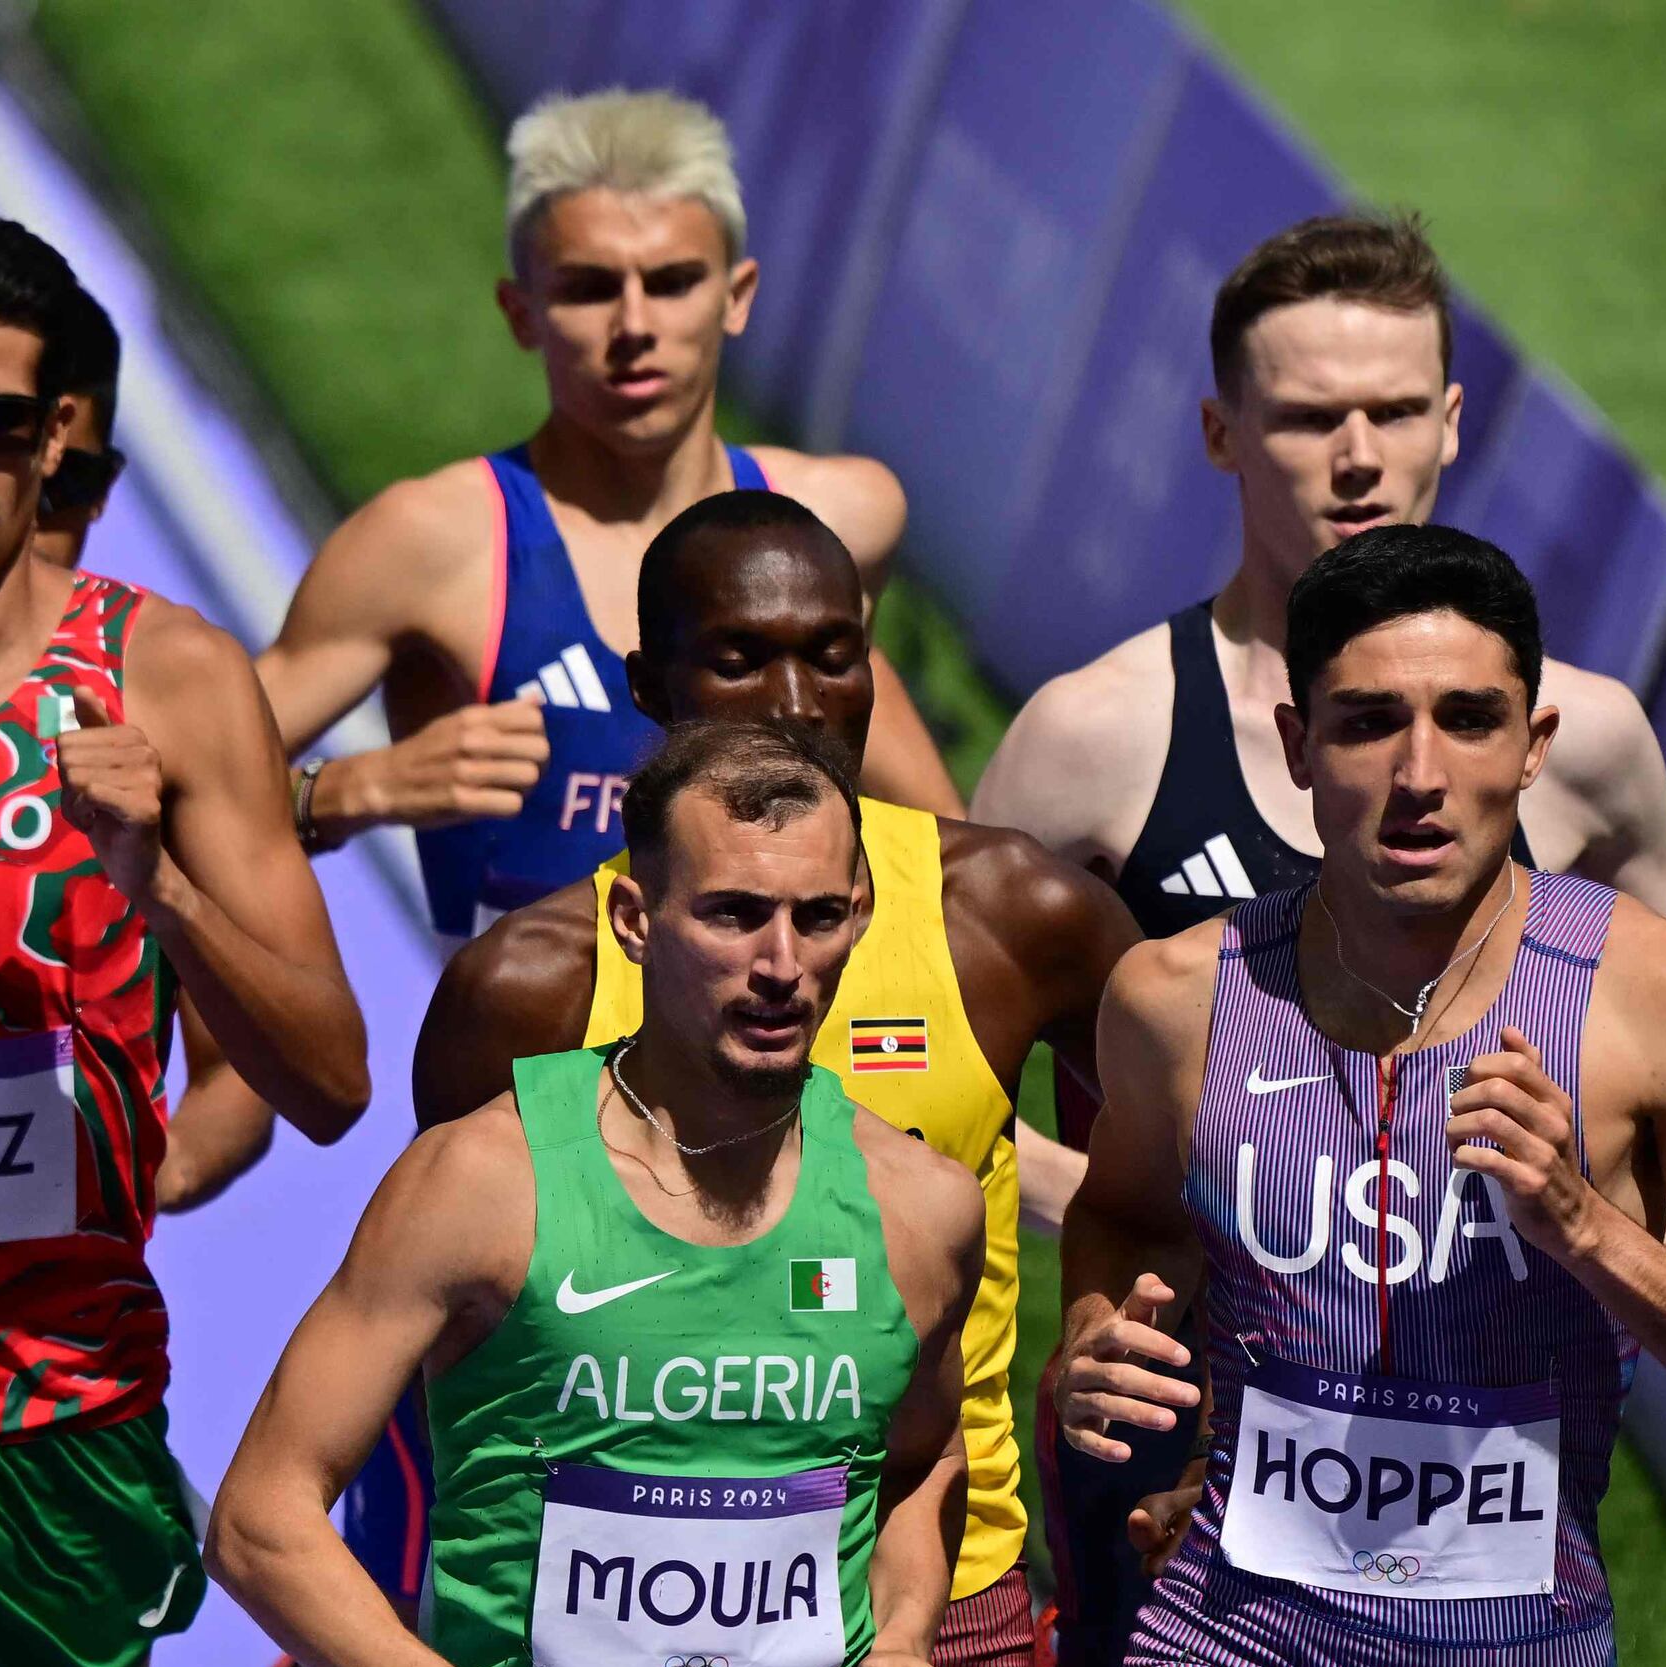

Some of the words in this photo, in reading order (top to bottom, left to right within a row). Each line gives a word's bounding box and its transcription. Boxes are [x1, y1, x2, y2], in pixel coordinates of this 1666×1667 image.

[1236, 1142, 1530, 1286] USA
[556, 1353, 862, 1422] ALGERIA
[1316, 1379, 1396, 1408] PARIS
[1406, 1391, 1481, 1417] 2024
[632, 1485, 712, 1508] PARIS
[722, 1487, 787, 1509] 2024
[1252, 1428, 1544, 1527] HOPPEL
[566, 1548, 818, 1628] MOULA
